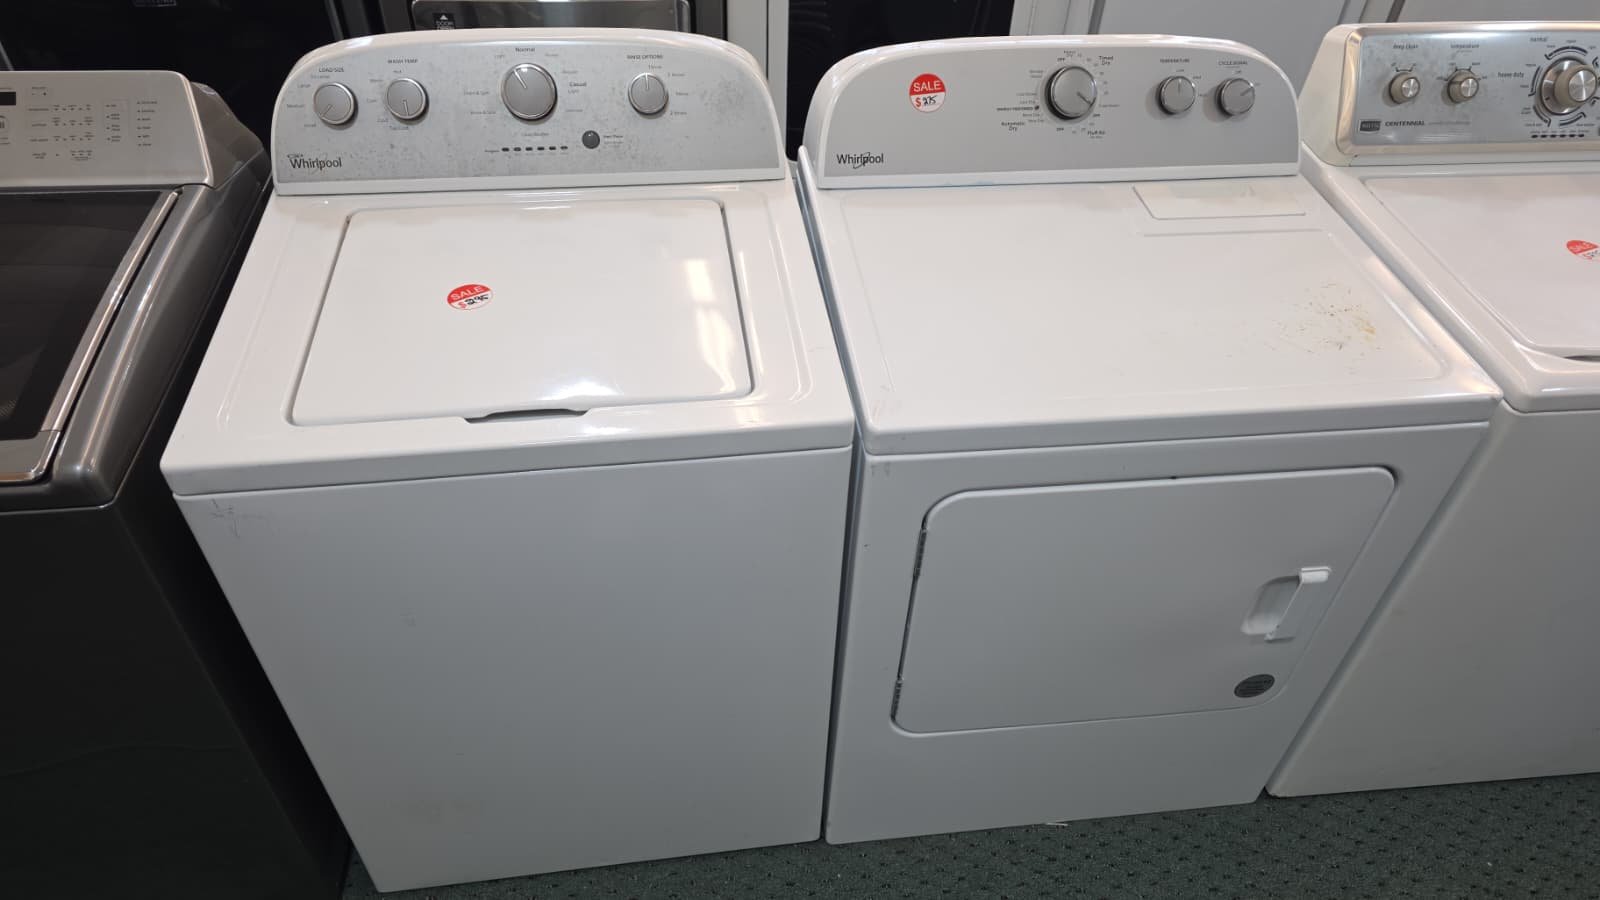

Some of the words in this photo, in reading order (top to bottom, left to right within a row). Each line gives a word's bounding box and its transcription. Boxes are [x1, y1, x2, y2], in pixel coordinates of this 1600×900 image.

[913, 80, 942, 93] SALE
[290, 157, 342, 171] Whirlpool
[837, 153, 884, 167] Whirlpool
[450, 286, 484, 301] SALE
